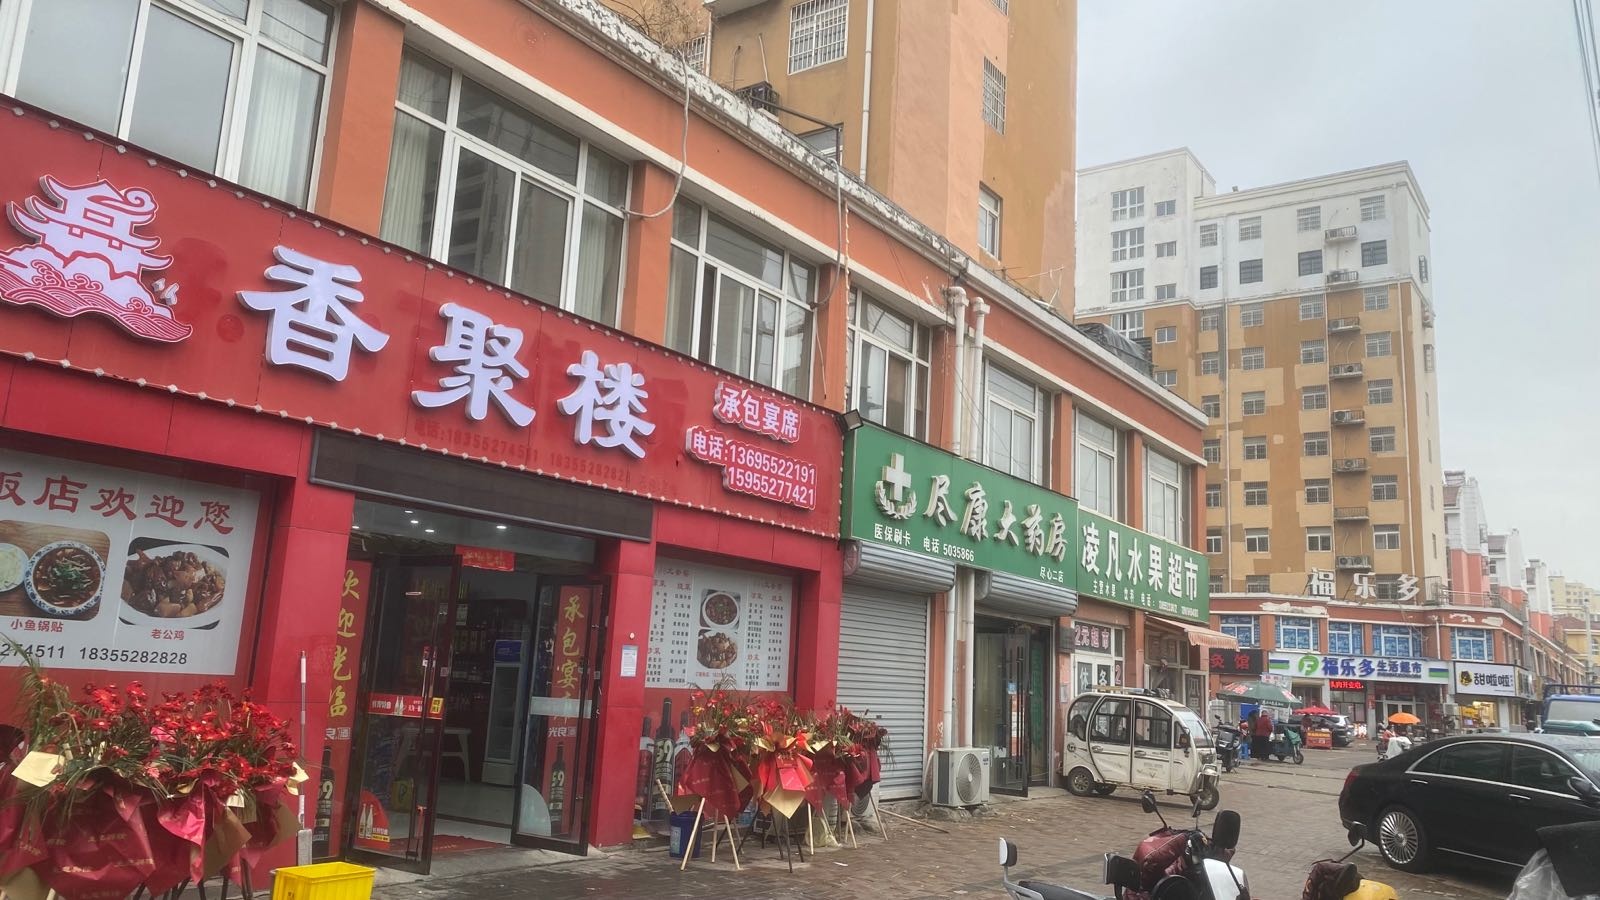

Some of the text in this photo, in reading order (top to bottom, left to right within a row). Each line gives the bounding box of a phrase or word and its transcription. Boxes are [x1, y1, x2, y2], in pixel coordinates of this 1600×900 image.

[236, 244, 656, 459] 香聚楼
[720, 386, 799, 439] 承包宴席
[693, 430, 815, 486] 电话:13695522191
[728, 466, 814, 506] 15955277421
[922, 473, 1069, 563] 尽康大药房
[874, 523, 975, 562] 医保刷卡 电话 5035866
[1081, 521, 1200, 602] 凌凡水果超市
[1309, 567, 1420, 601] 福乐多
[10, 618, 185, 641] 小鱼锅贴 老公鸡
[1074, 624, 1110, 650] 2元超市
[79, 647, 188, 665] 18355282828
[554, 595, 584, 725] 承包宴
[1322, 655, 1376, 678] 福乐多
[1376, 658, 1422, 674] 生活超市
[1474, 671, 1511, 688] 甜啦啦
[656, 740, 674, 762] 59
